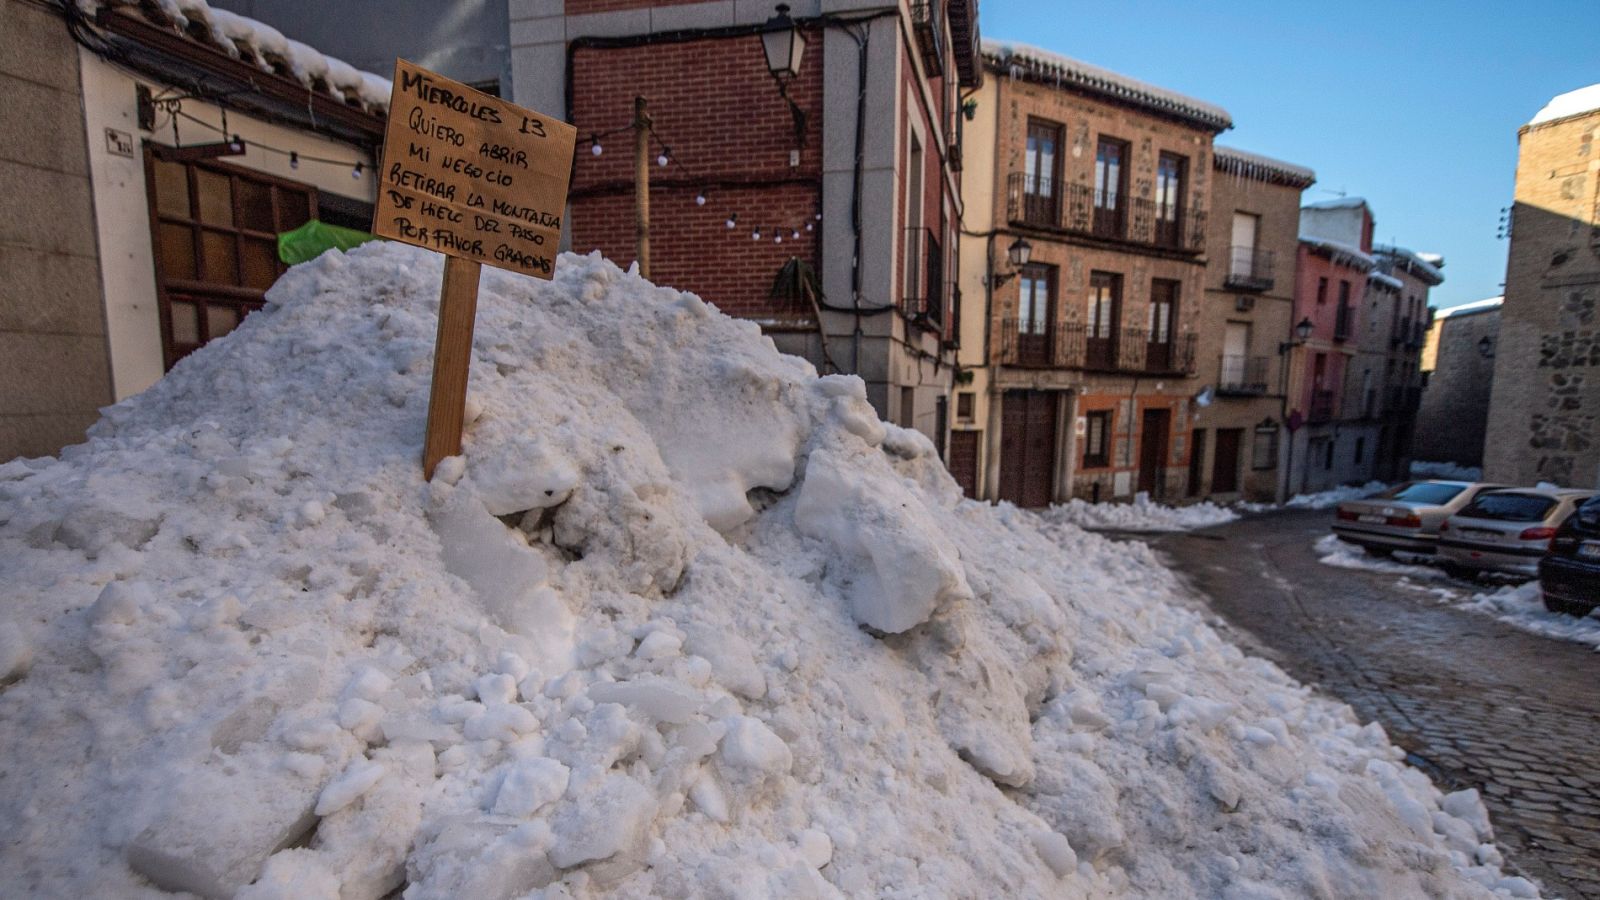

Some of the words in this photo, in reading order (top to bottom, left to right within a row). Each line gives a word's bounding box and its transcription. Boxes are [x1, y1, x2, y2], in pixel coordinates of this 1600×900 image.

[401, 70, 502, 124] MIERCOLES
[518, 117, 546, 138] 13
[409, 107, 465, 147] QUIERO
[479, 143, 529, 168] ABRIR
[410, 143, 430, 162] MI
[442, 158, 512, 186] NEGOCIO
[387, 190, 411, 208] DE
[475, 216, 501, 233] DEL
[509, 223, 544, 245] PASO
[390, 163, 455, 200] RETIRAR
[467, 193, 484, 207] LA
[493, 199, 560, 230] MONTAÑA
[394, 217, 428, 240] POR
